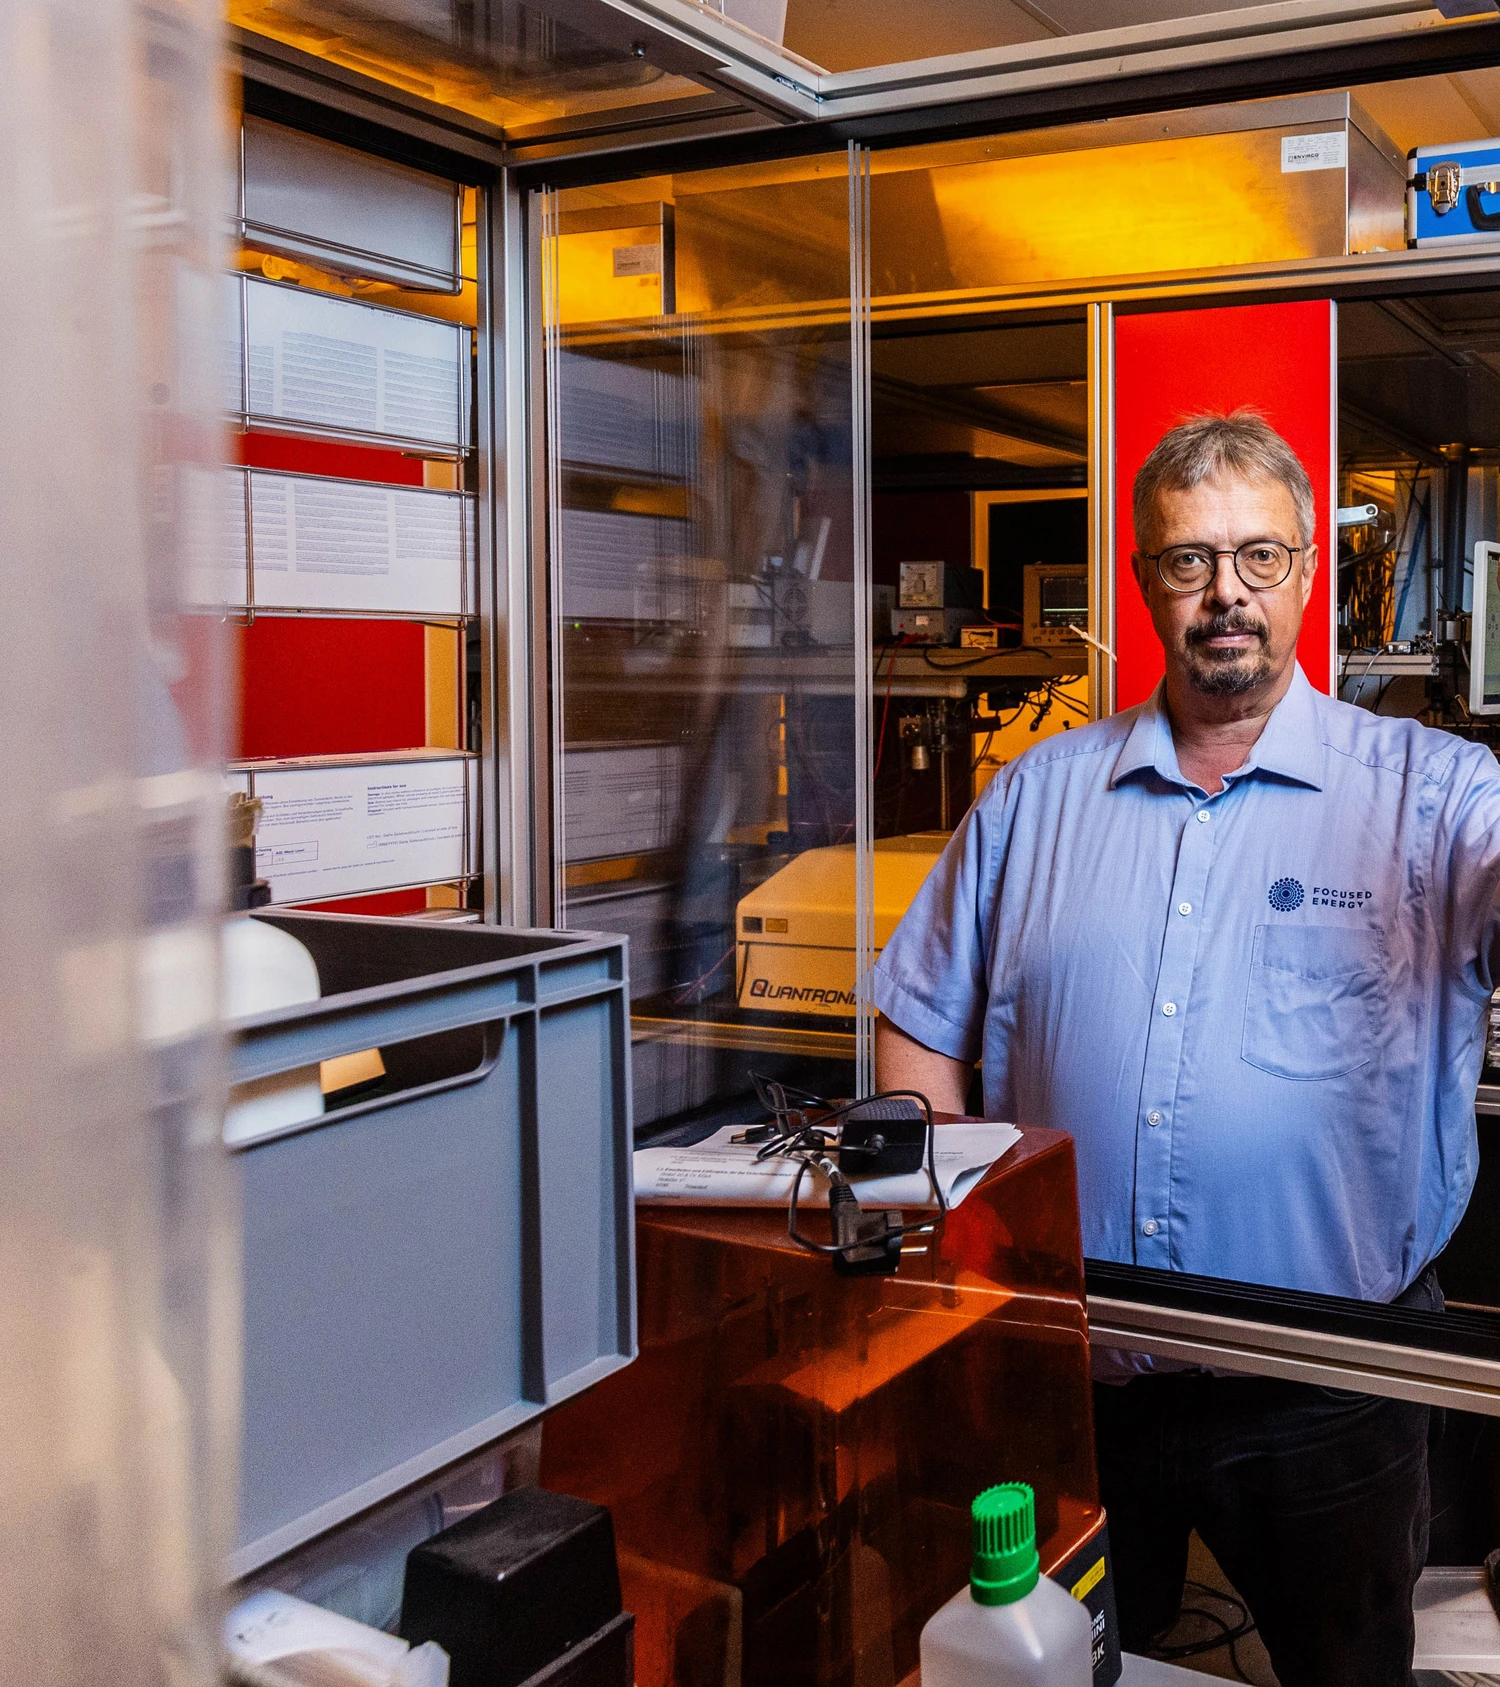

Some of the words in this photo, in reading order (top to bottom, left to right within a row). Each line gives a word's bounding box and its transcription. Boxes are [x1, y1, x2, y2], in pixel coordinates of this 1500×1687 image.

[1313, 887, 1372, 899] FOCUSED
[1312, 897, 1364, 909] ENERGY
[750, 978, 857, 1006] QUANTRONI
